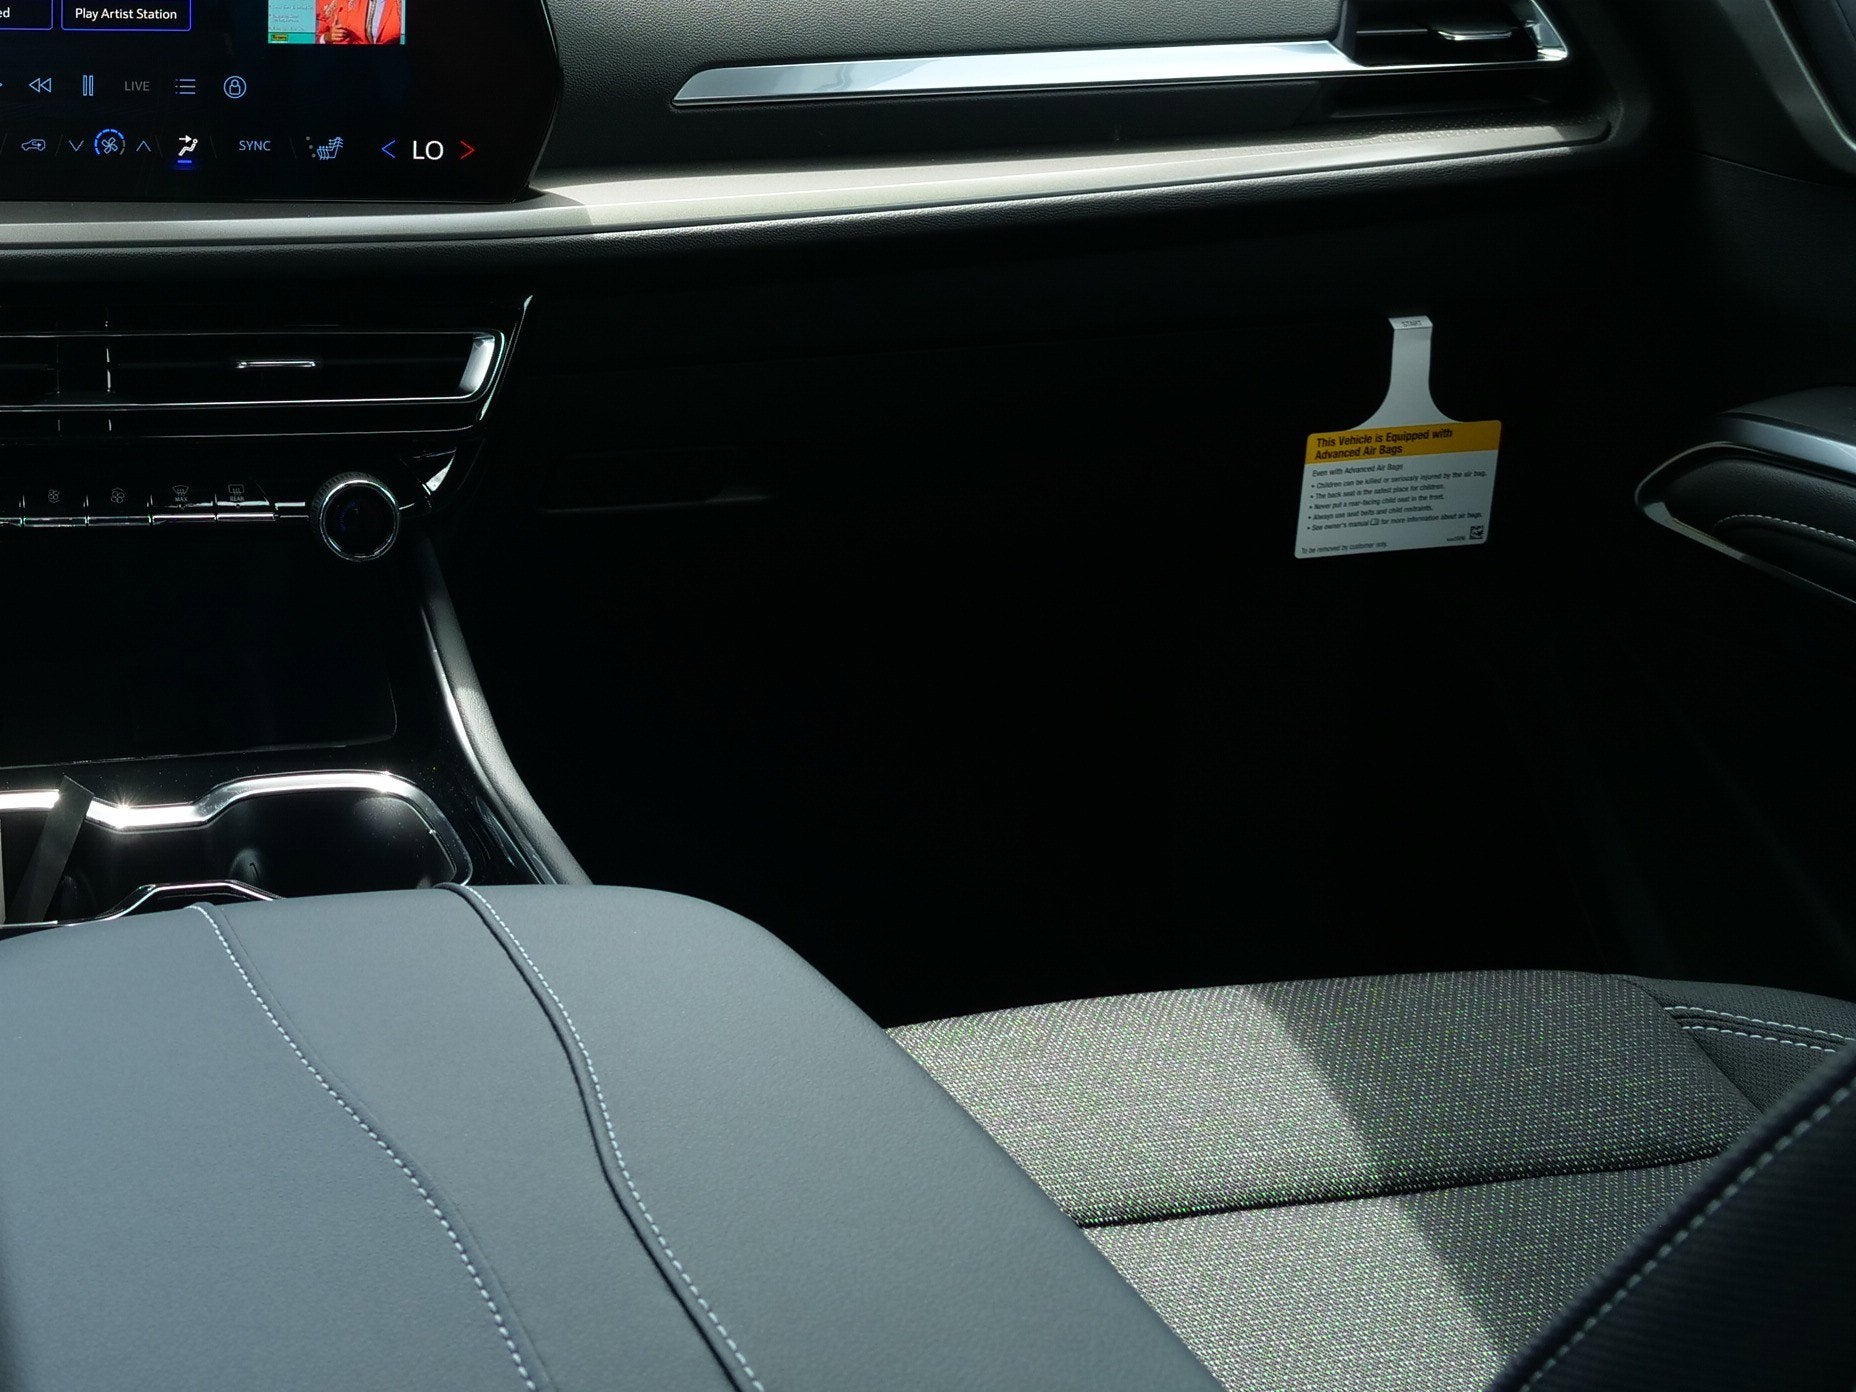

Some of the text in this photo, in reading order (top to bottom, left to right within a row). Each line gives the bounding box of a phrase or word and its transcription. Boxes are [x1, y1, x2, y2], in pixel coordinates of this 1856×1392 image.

[75, 8, 178, 22] Play Artist Station
[124, 82, 150, 91] LIVE
[239, 140, 271, 153] SYNC
[412, 140, 445, 160] LO
[1317, 428, 1453, 448] This Vehicle is Equipped with
[1315, 445, 1403, 460] Advanced Air Bags
[1330, 468, 1343, 476] with
[1344, 466, 1375, 474] Advanced
[1387, 464, 1403, 472] Bags
